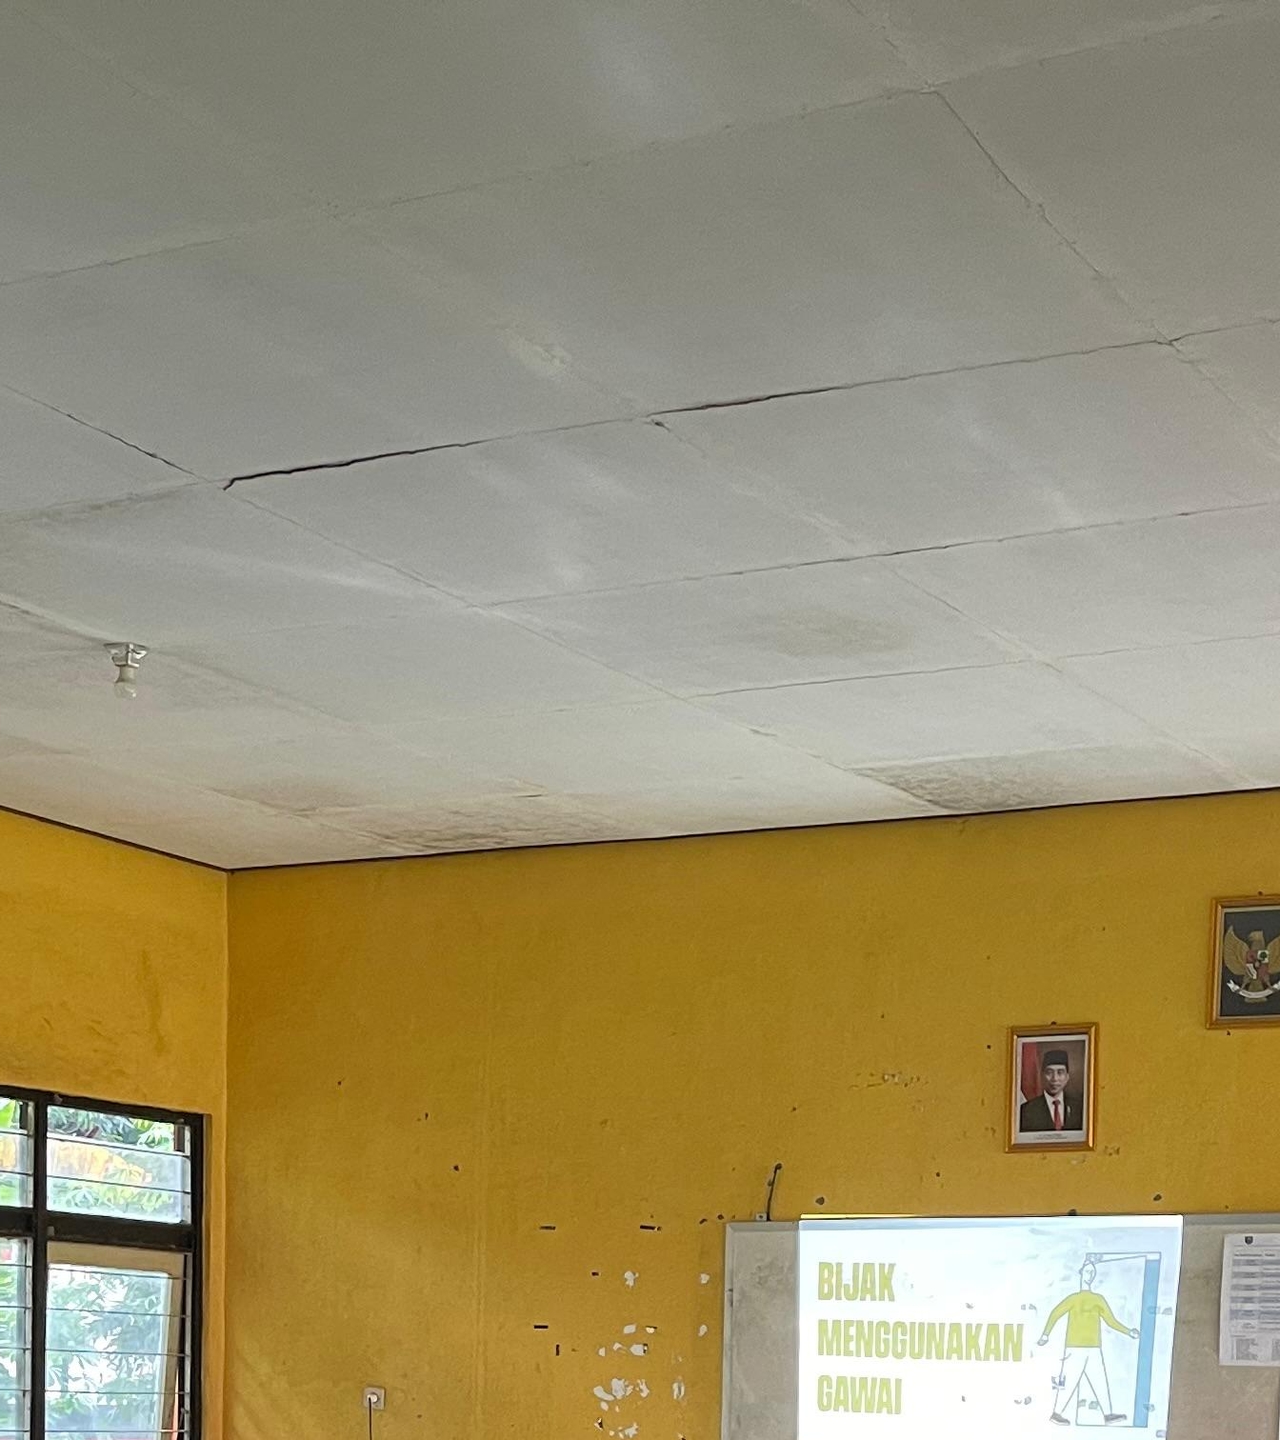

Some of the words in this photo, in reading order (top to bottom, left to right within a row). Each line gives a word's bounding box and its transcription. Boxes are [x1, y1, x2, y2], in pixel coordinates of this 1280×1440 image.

[818, 1261, 897, 1302] BIJAK
[817, 1318, 1024, 1362] MENGGUNAKAN
[817, 1374, 903, 1415] GAWAI
